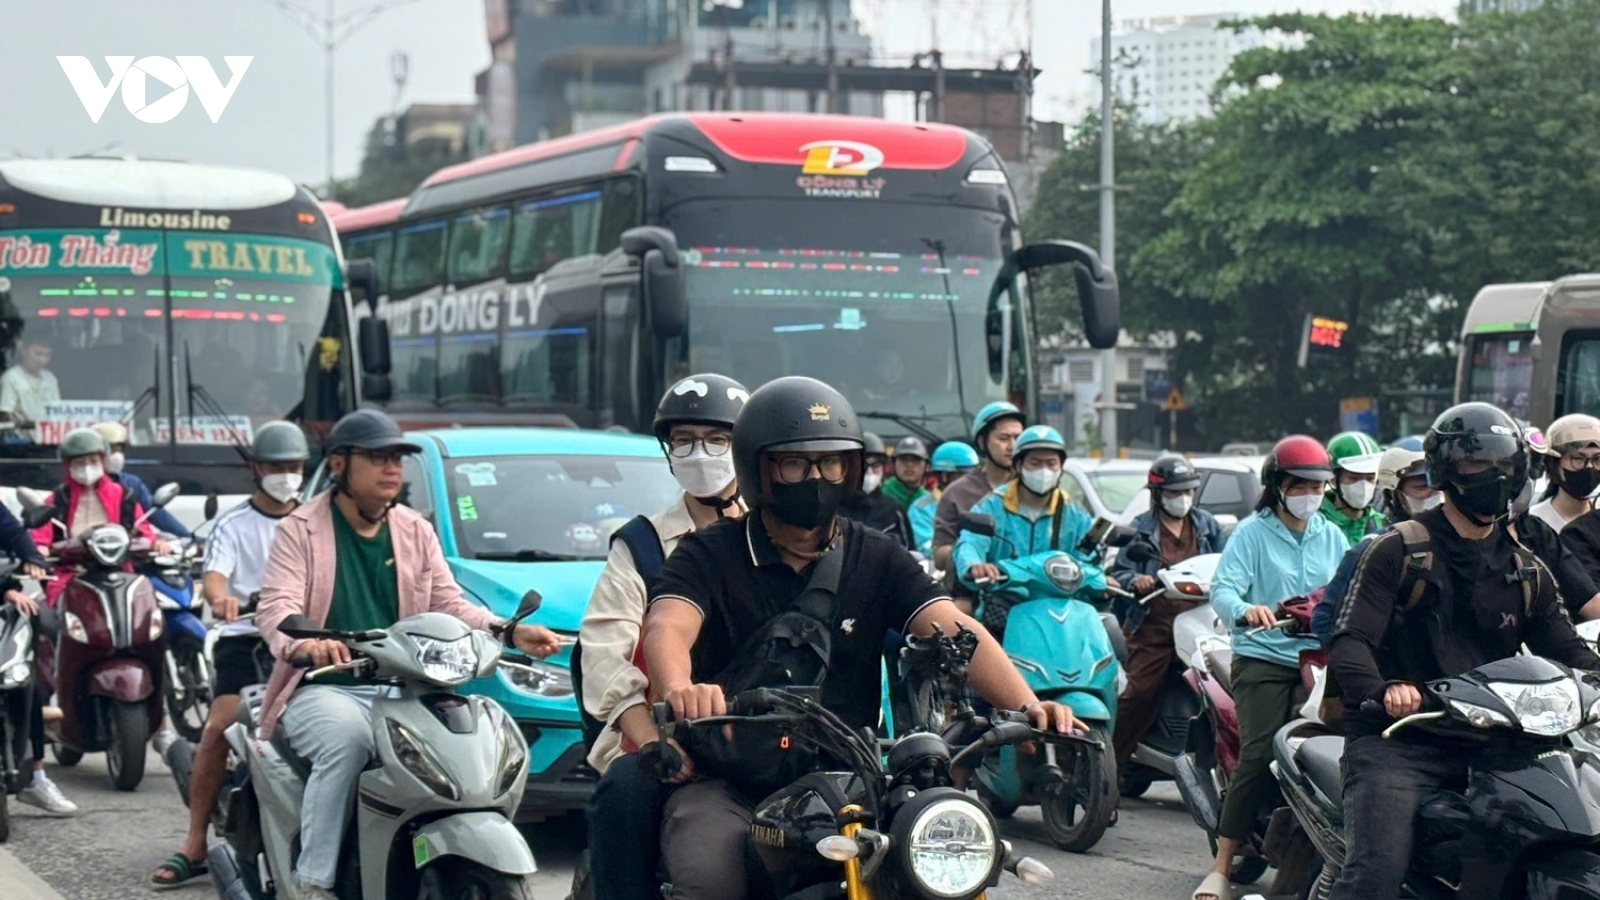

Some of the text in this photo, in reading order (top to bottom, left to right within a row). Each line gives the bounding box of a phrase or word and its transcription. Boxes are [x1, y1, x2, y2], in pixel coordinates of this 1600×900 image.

[805, 188, 880, 199] TRANSPORT
[100, 207, 231, 230] Limousine
[0, 229, 157, 275] Tôn Thắng
[184, 239, 313, 276] TRAVEL
[419, 284, 500, 334] ĐÔNG
[509, 273, 548, 327] LÝ
